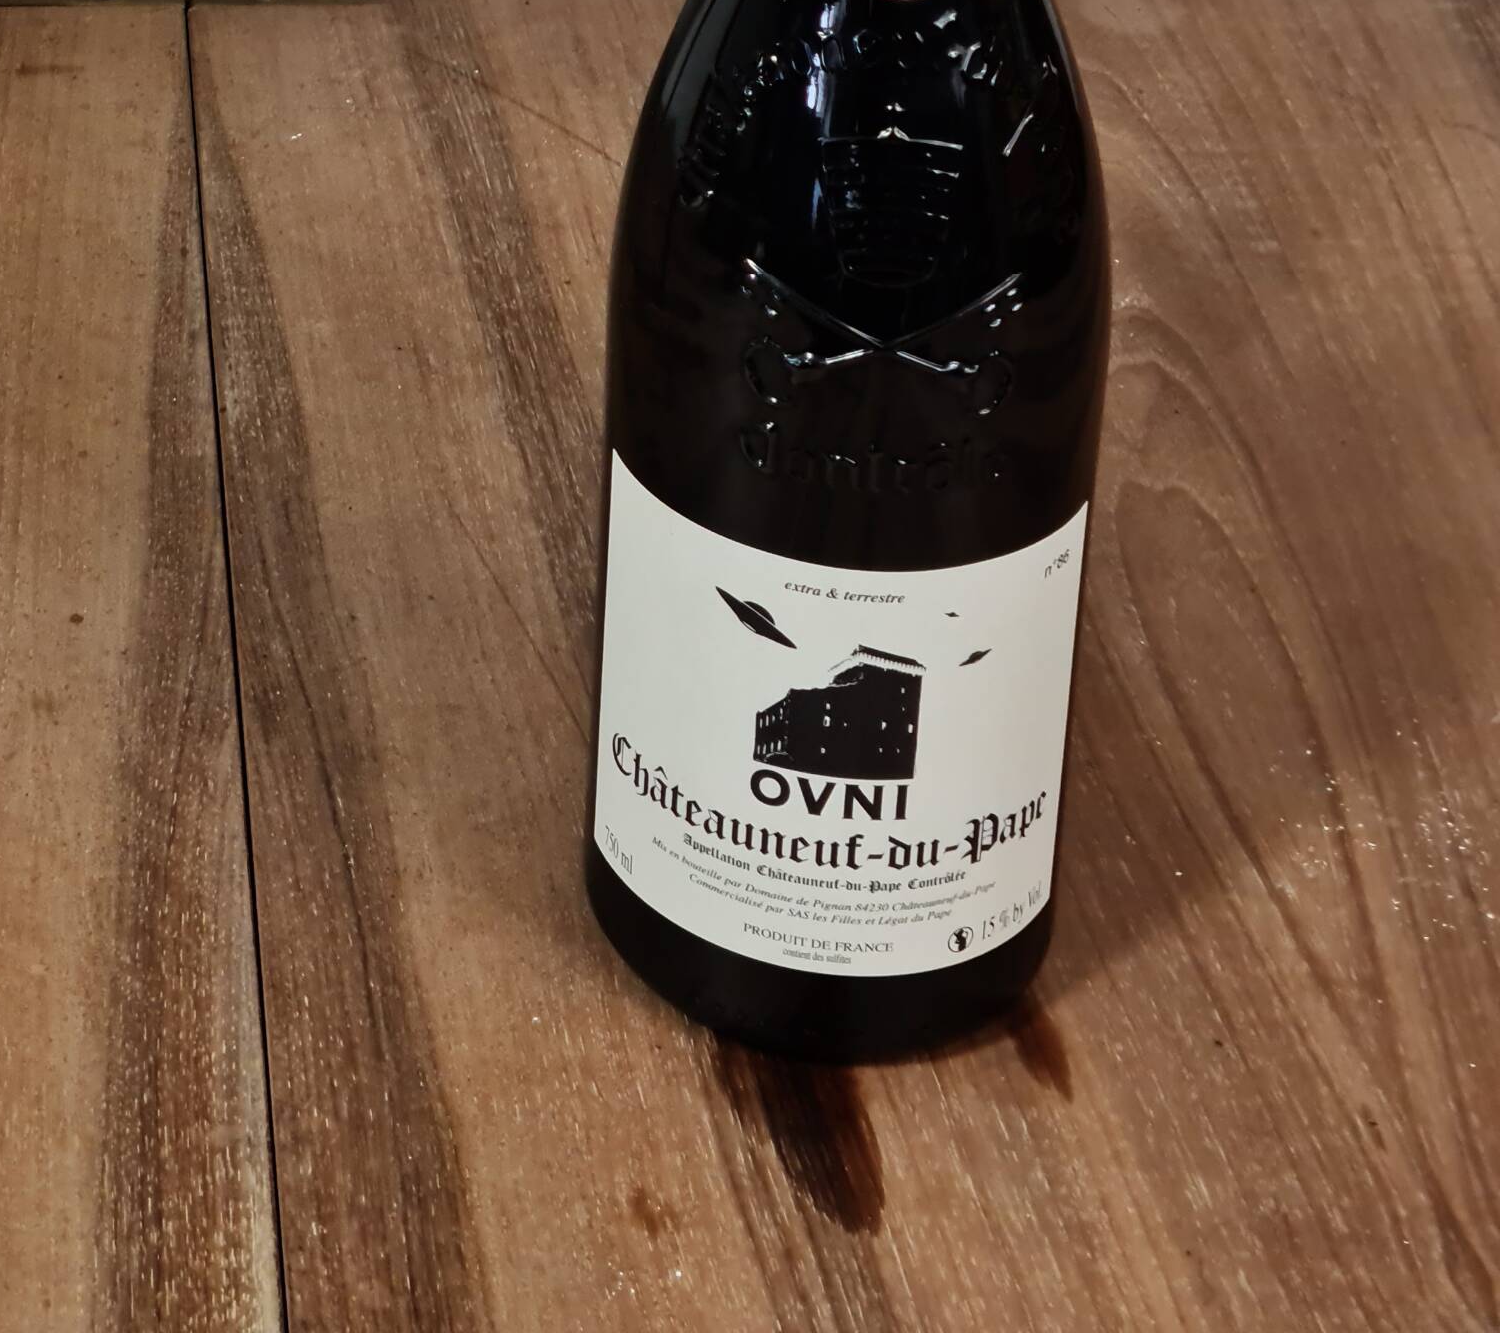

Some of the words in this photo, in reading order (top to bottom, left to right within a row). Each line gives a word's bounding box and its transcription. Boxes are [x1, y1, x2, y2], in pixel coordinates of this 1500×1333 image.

[784, 582, 821, 596] extra
[826, 587, 839, 599] &
[843, 590, 905, 604] terrestre
[612, 733, 1047, 870] Châteauneuf-du-Pape
[750, 769, 909, 821] OVNI
[605, 825, 619, 859] 750
[621, 855, 633, 875] ml
[652, 836, 667, 851] Mis
[669, 850, 680, 861] en
[681, 856, 722, 881] bouteille
[723, 876, 742, 889] par
[745, 883, 793, 903] Domaine
[796, 896, 809, 906] de
[813, 899, 851, 913] Pignan
[854, 903, 889, 913] 84230
[683, 833, 750, 871] Appellation
[756, 864, 902, 894] Châteauneuf-du-Pape
[908, 870, 966, 890] Contrôlée
[689, 873, 763, 909] Commercialisé
[765, 904, 784, 916] par
[788, 908, 810, 920] SAS
[812, 912, 827, 923] les
[830, 915, 861, 925] Filles
[864, 917, 875, 926] et
[910, 912, 924, 923] du
[927, 908, 952, 922] Pape
[743, 922, 808, 947] PRODUIT
[811, 939, 831, 950] DE
[835, 941, 894, 952] FRANCE
[982, 915, 995, 940] 15
[782, 948, 811, 960] contient
[812, 953, 824, 962] des
[826, 954, 852, 965] sulfites
